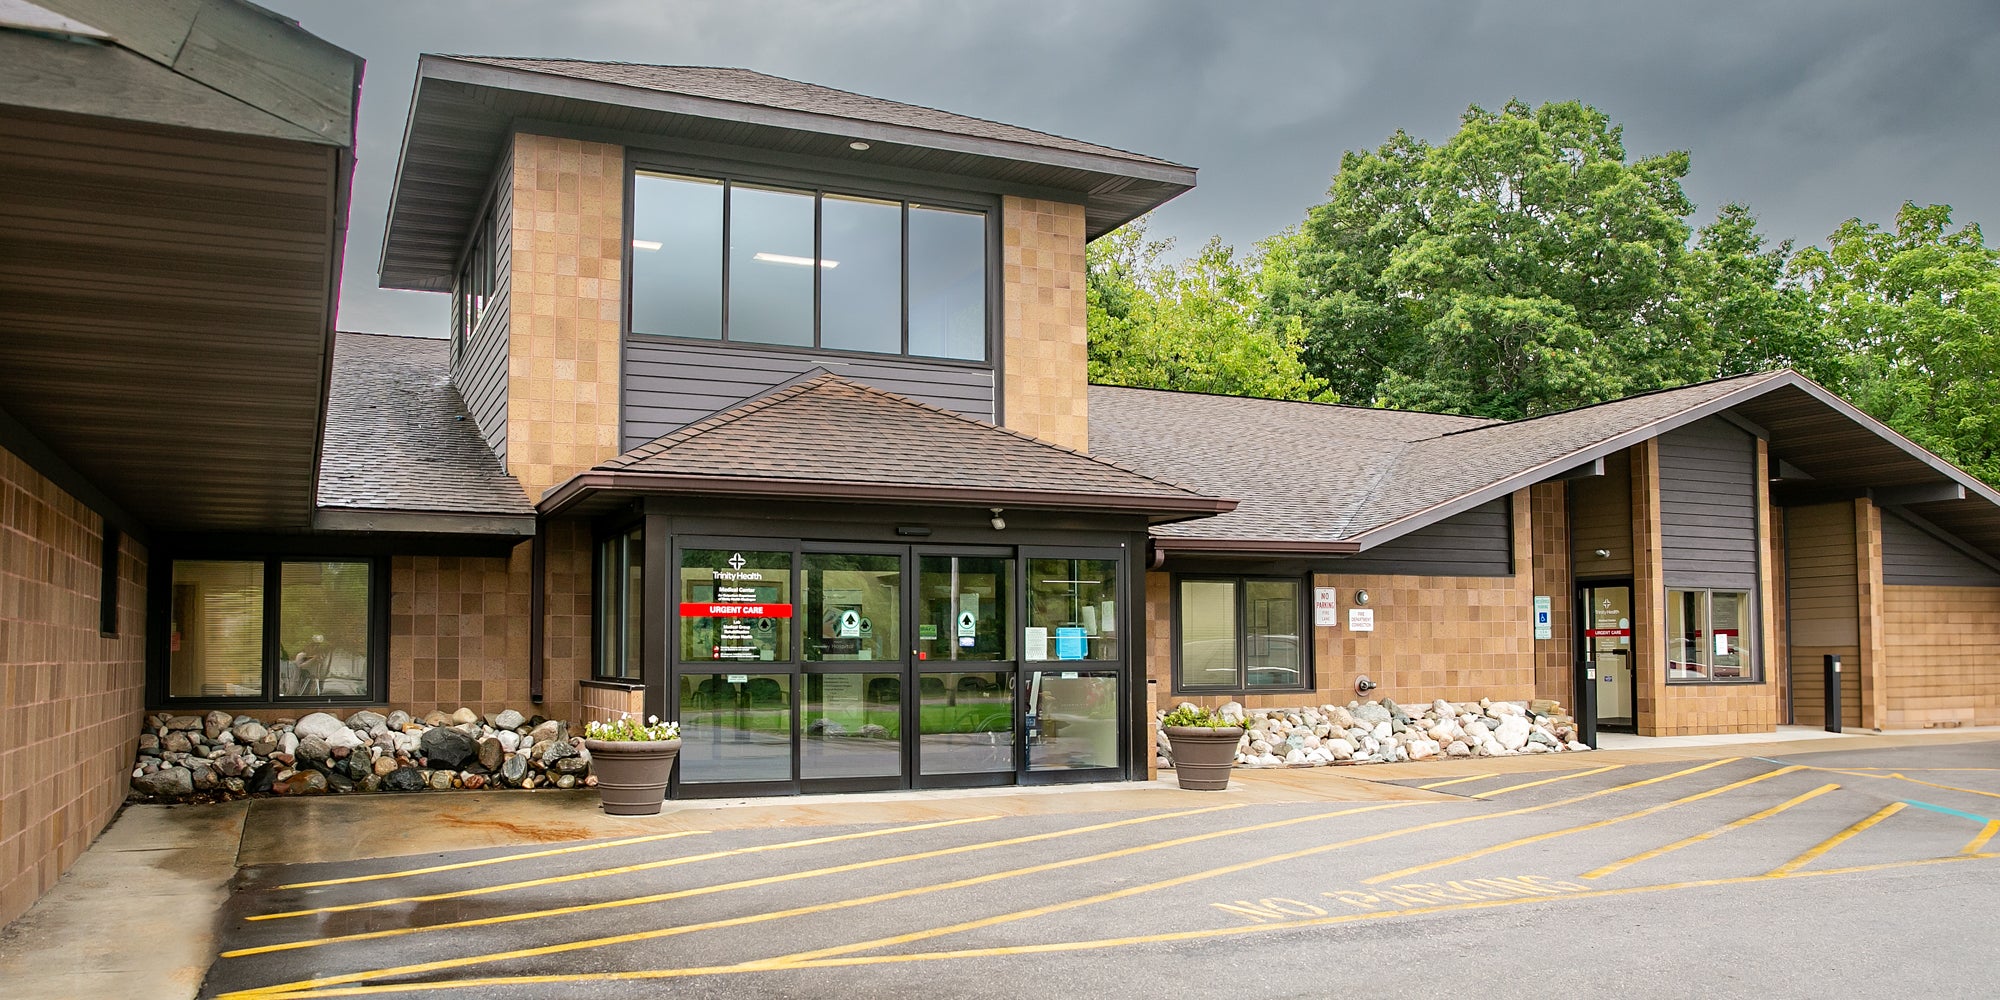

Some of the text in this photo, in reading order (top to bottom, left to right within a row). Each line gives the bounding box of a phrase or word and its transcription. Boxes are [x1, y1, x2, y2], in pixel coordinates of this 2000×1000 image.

[713, 571, 762, 581] Trinity Health
[709, 606, 763, 614] URGENT CARE
[1209, 876, 1591, 922] NO PARKING
